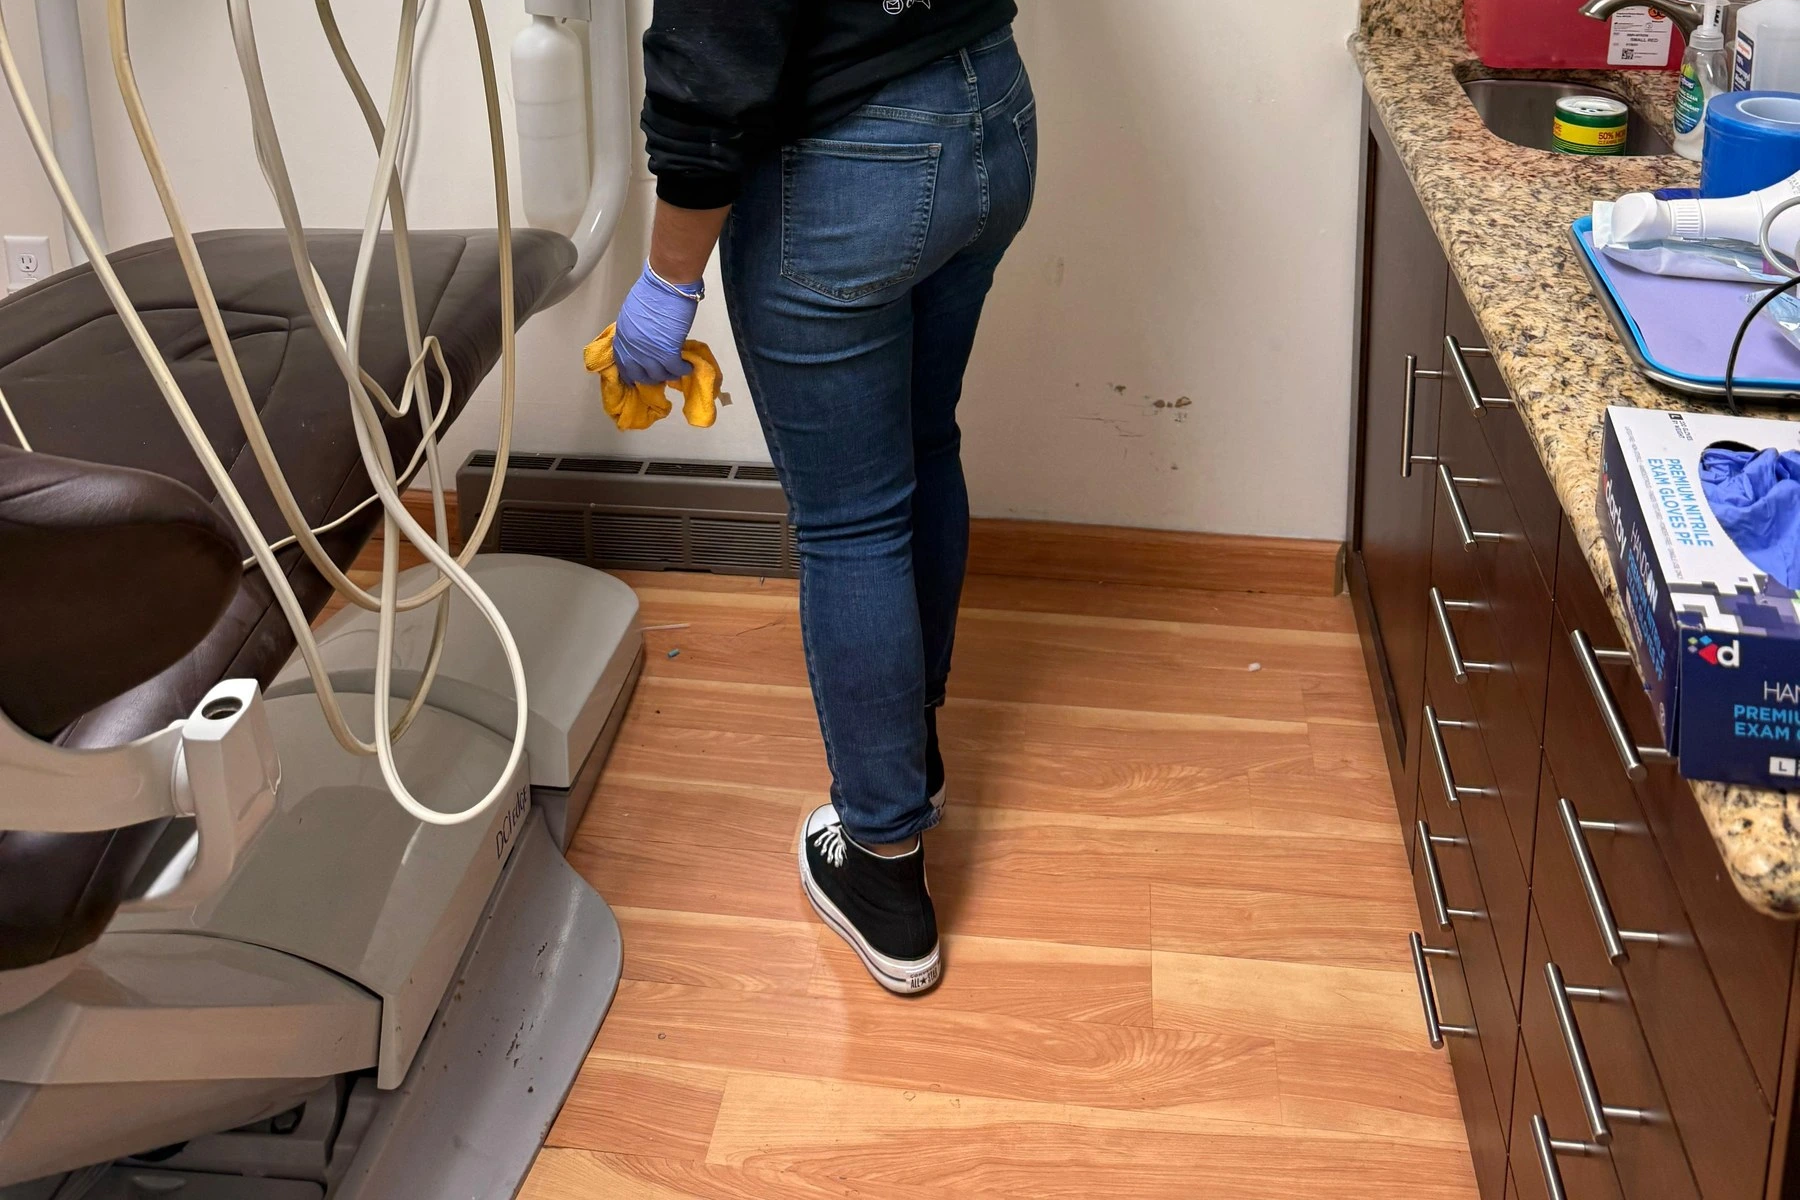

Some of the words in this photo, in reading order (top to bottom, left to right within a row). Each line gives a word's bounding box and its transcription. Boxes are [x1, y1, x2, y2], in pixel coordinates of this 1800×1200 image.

[1598, 131, 1614, 141] 50%
[1648, 458, 1671, 485] EXAM
[1659, 486, 1688, 530] GLOVES
[1665, 458, 1697, 502] PREMIUM
[1684, 504, 1715, 547] NITRILE
[1605, 479, 1628, 560] darby
[1675, 531, 1694, 546] PF
[1734, 721, 1790, 741] EXAM
[1778, 760, 1788, 772] L
[911, 977, 921, 989] ALL
